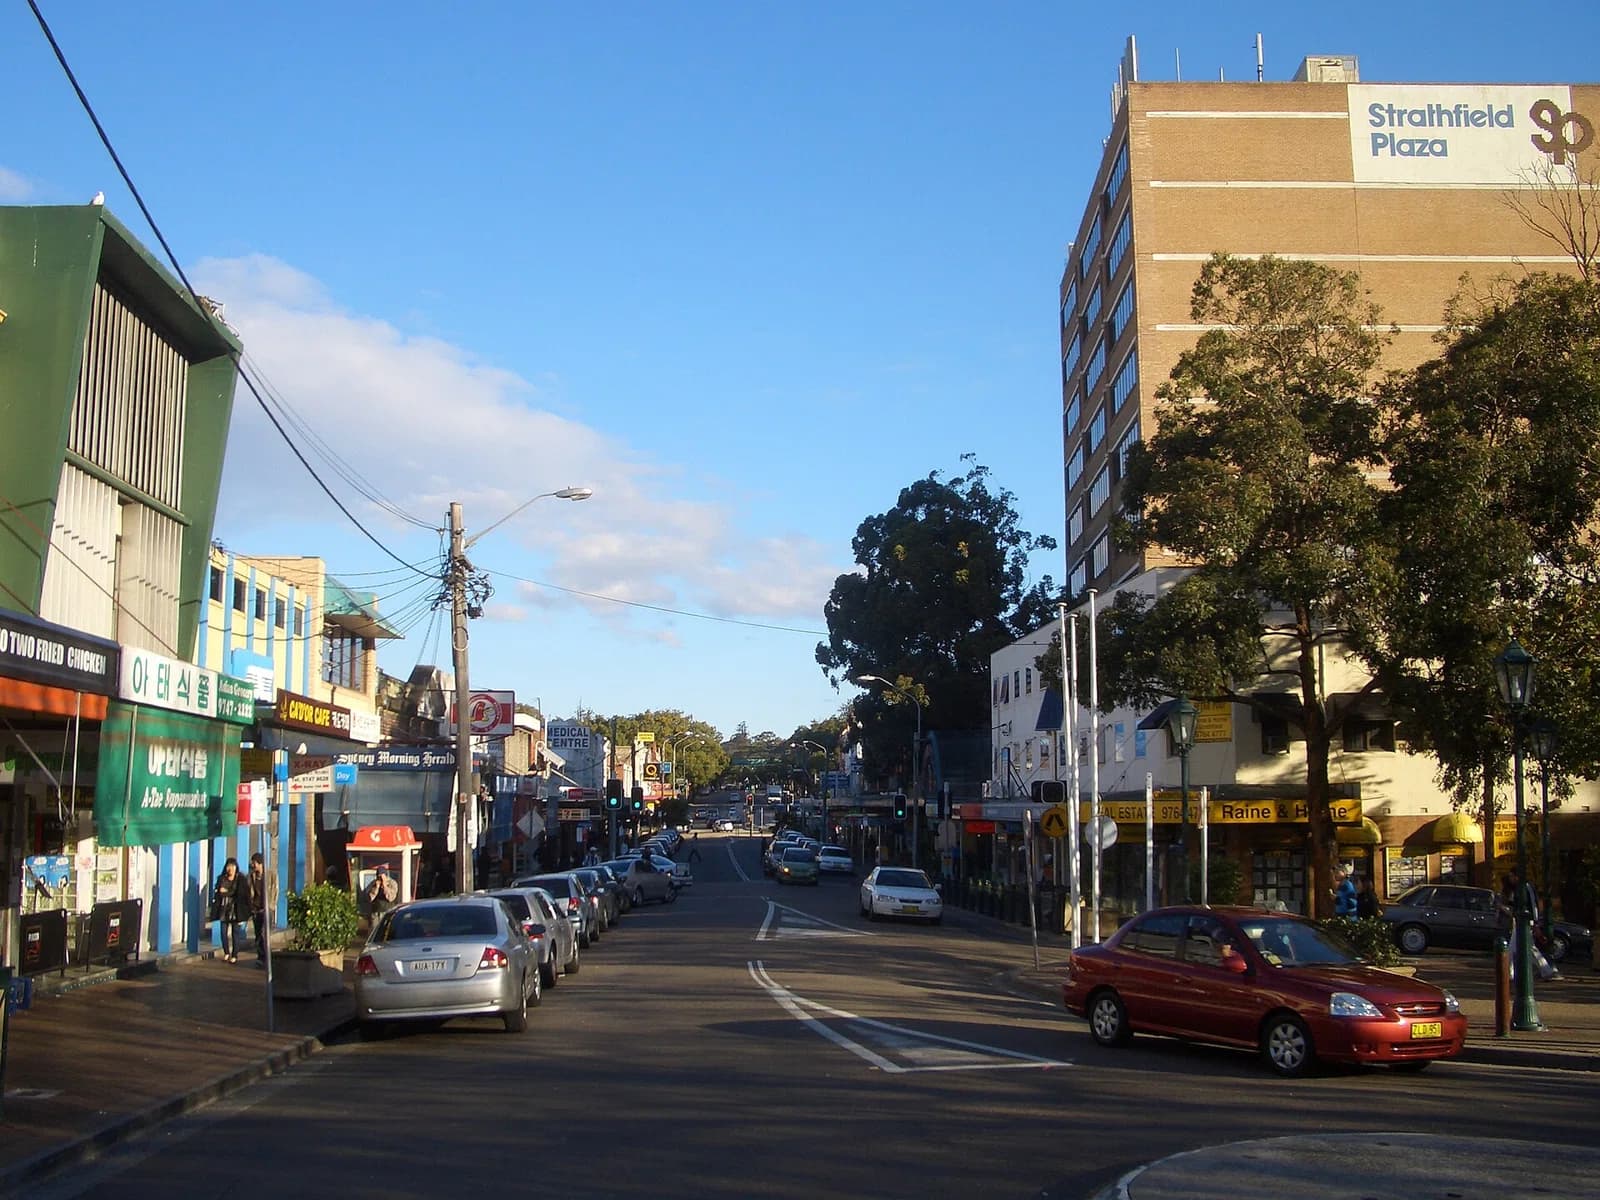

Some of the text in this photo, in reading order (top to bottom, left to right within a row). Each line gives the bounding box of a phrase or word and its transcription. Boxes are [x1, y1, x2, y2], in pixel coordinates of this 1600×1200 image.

[1368, 103, 1514, 128] Strathfield
[1371, 132, 1448, 157] Plaza
[9, 631, 35, 659] TWO
[36, 638, 65, 666] FRIED
[67, 646, 107, 675] CHICKEN
[377, 750, 420, 767] Morning
[422, 751, 456, 768] Herald
[1222, 805, 1271, 819] Raine
[1278, 804, 1289, 819] &
